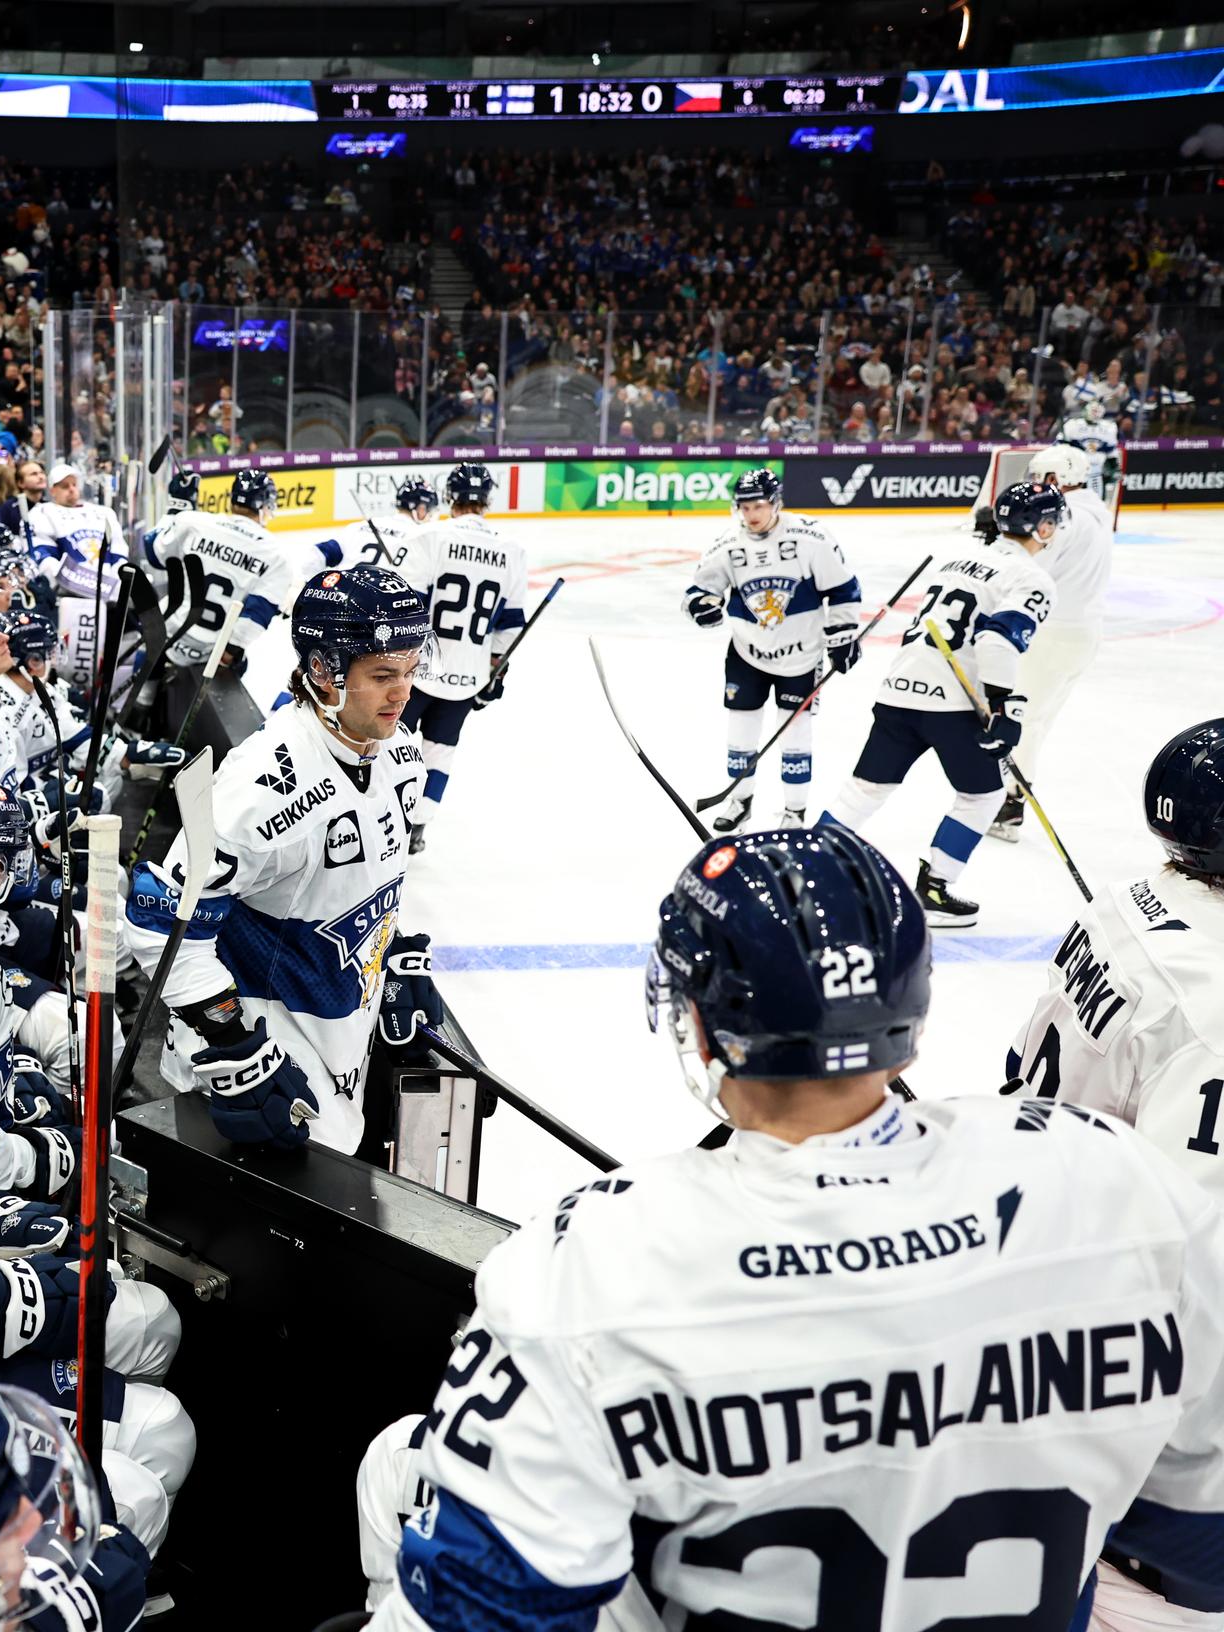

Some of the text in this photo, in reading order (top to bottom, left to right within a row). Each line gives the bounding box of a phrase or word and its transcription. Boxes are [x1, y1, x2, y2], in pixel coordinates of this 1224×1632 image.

[550, 84, 663, 113] 1 18:32 0
[736, 445, 769, 454] intrum
[785, 445, 818, 454] intrum
[833, 445, 866, 454] intrum
[882, 444, 915, 453] intrum
[929, 444, 963, 453] intrum
[1126, 440, 1159, 450] intrum
[1175, 439, 1209, 449] intrum
[370, 450, 398, 460] intrum
[411, 449, 440, 459] intrum
[454, 448, 484, 458] intrum
[499, 447, 530, 457] intrum
[545, 447, 577, 456] intrum
[593, 446, 625, 456] intrum
[639, 446, 672, 455] intrum
[688, 445, 721, 455] intrum
[260, 456, 284, 466] intrum
[294, 454, 320, 464] intrum
[331, 452, 358, 462] intrum
[200, 460, 221, 471] intrum
[229, 458, 251, 469] intrum
[596, 463, 734, 508] planex
[870, 475, 982, 499] VEIKKAUS
[190, 536, 269, 577] LAAKSONEN
[448, 543, 506, 569] HATAKKA
[742, 576, 791, 594] SUOMI
[392, 599, 418, 609] CCM
[432, 572, 501, 646] 28
[298, 626, 324, 639] CCM
[256, 777, 337, 842] VEIKKAUS
[1156, 795, 1174, 823] 10
[62, 852, 70, 888] CCM
[136, 894, 157, 909] OP
[665, 946, 693, 977] CCM
[819, 944, 877, 1000] 22
[391, 1013, 402, 1037] CCM
[210, 1042, 284, 1092] CCM
[15, 1097, 28, 1115] CCM
[31, 1223, 55, 1232] CCM
[294, 1239, 305, 1250] 72
[738, 1212, 988, 1279] GATORADE
[602, 1311, 1185, 1482] RUOTSALAINEN
